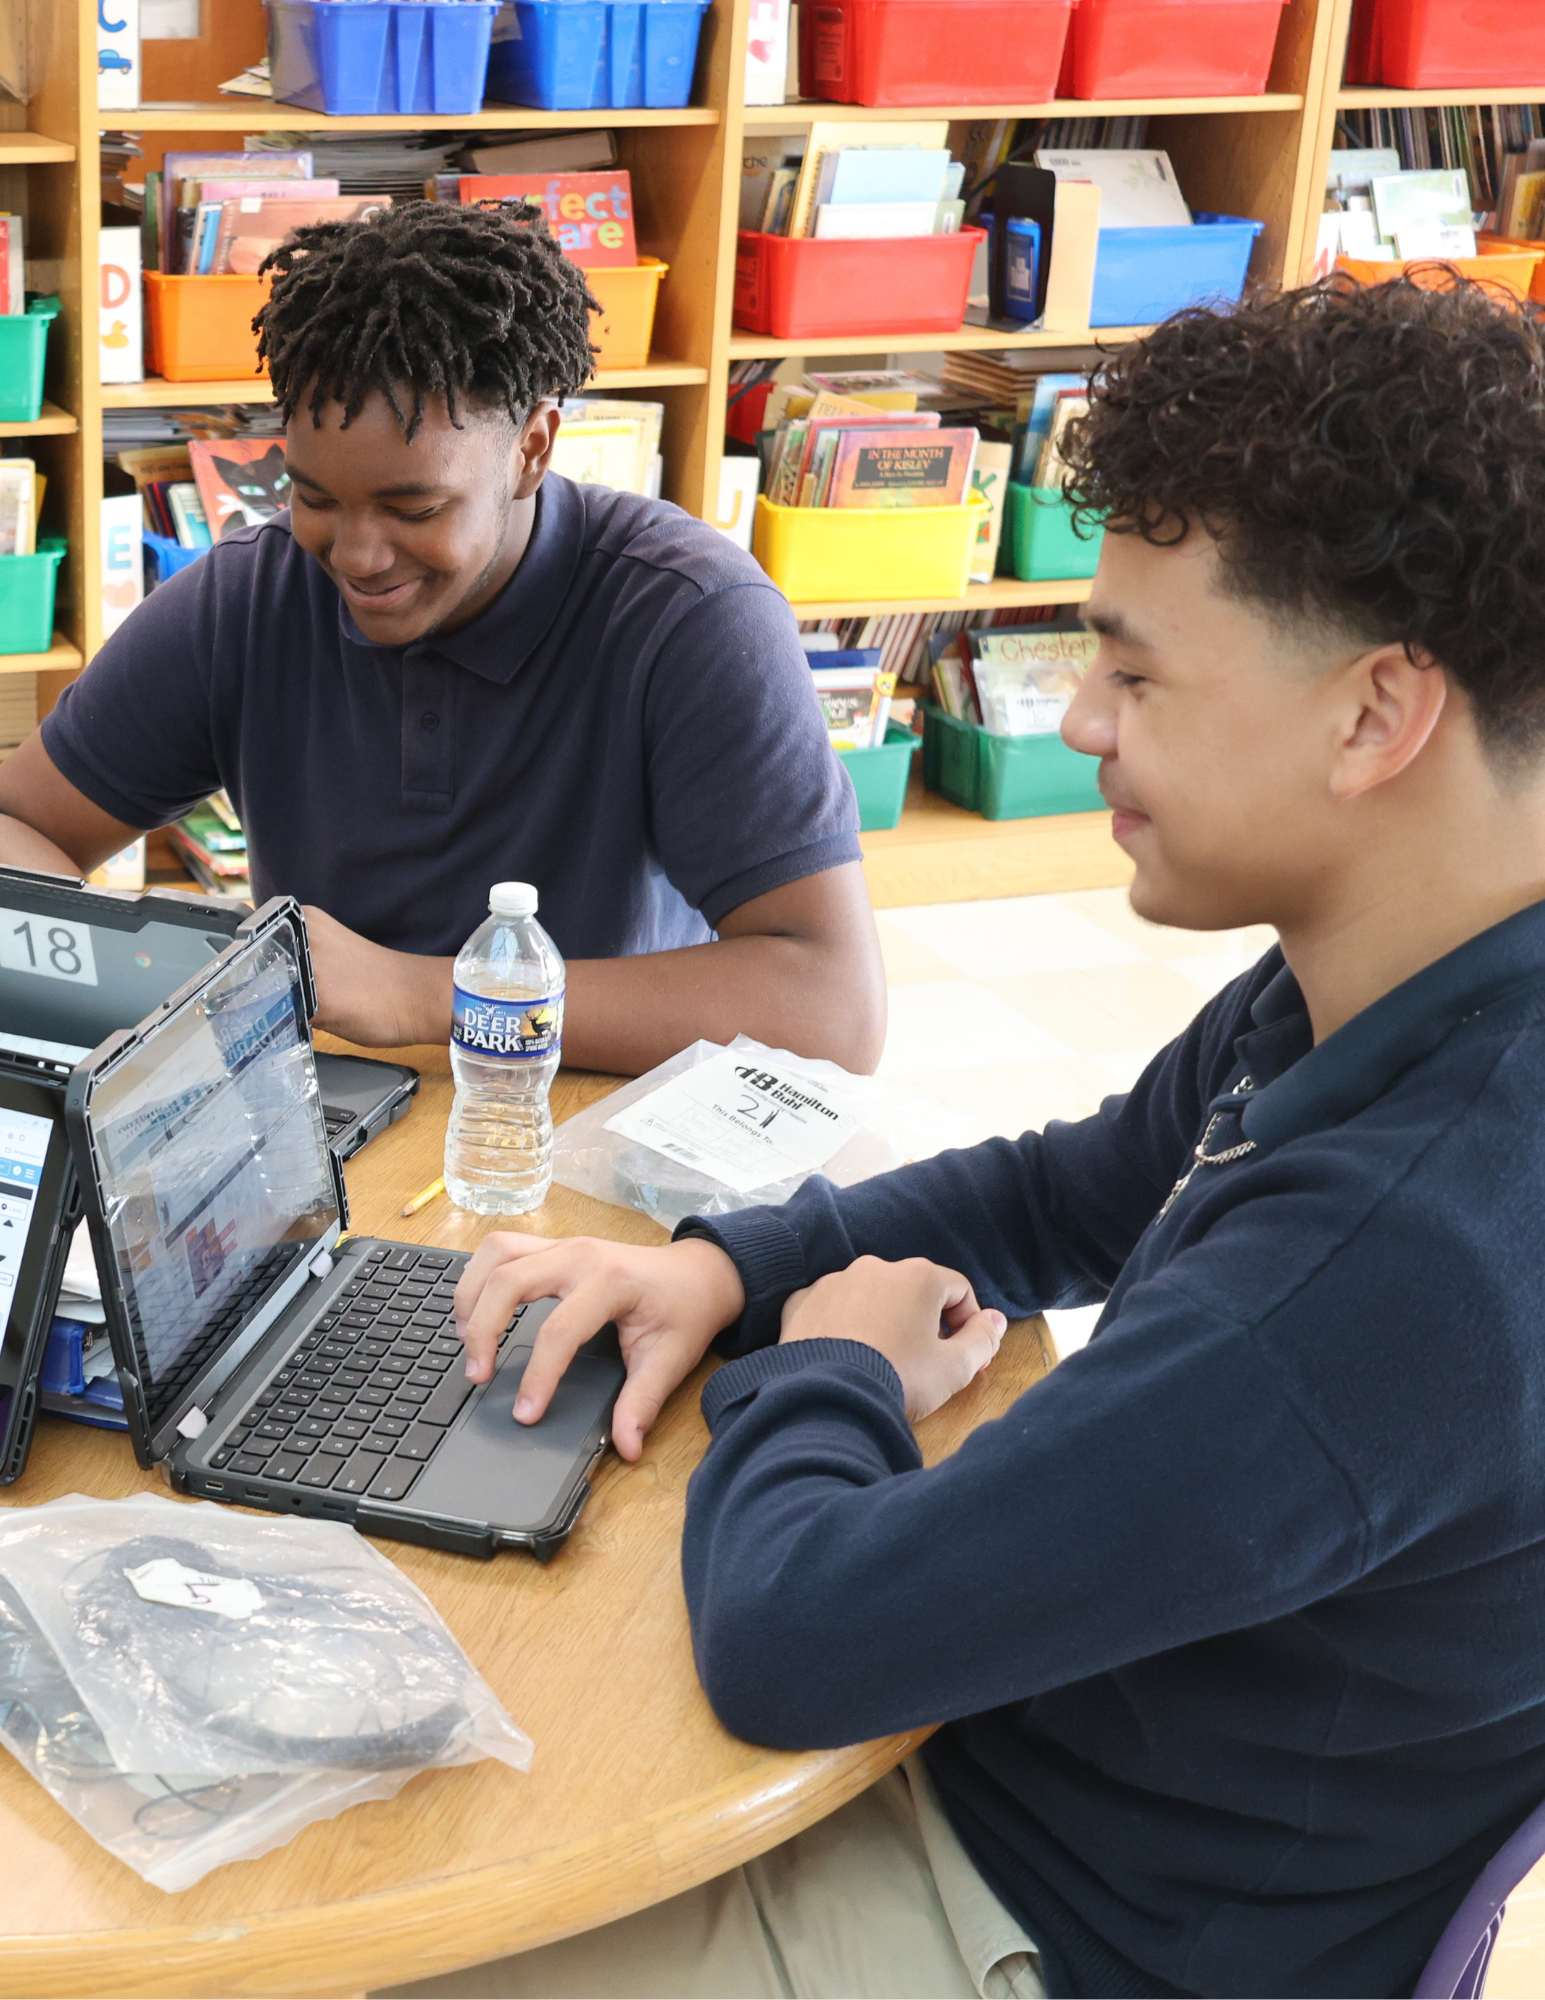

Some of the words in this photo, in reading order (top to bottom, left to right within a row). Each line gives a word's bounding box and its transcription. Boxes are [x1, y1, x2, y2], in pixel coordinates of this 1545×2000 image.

[471, 179, 629, 222] fect
[550, 221, 625, 251] are
[100, 263, 131, 310] D
[867, 449, 880, 460] IN
[882, 449, 903, 460] THE
[903, 448, 945, 459] MONTH
[877, 460, 893, 471] OF
[107, 525, 132, 571] E
[1000, 632, 1092, 662] Chester
[13, 920, 82, 975] 18
[464, 1007, 521, 1033] DEER
[462, 1025, 521, 1053] PARK
[771, 1090, 803, 1111] Buhl
[779, 1083, 839, 1121] Hamilton
[712, 1103, 729, 1117] This
[728, 1114, 762, 1138] Belongs
[9, 1205, 22, 1215] Less
